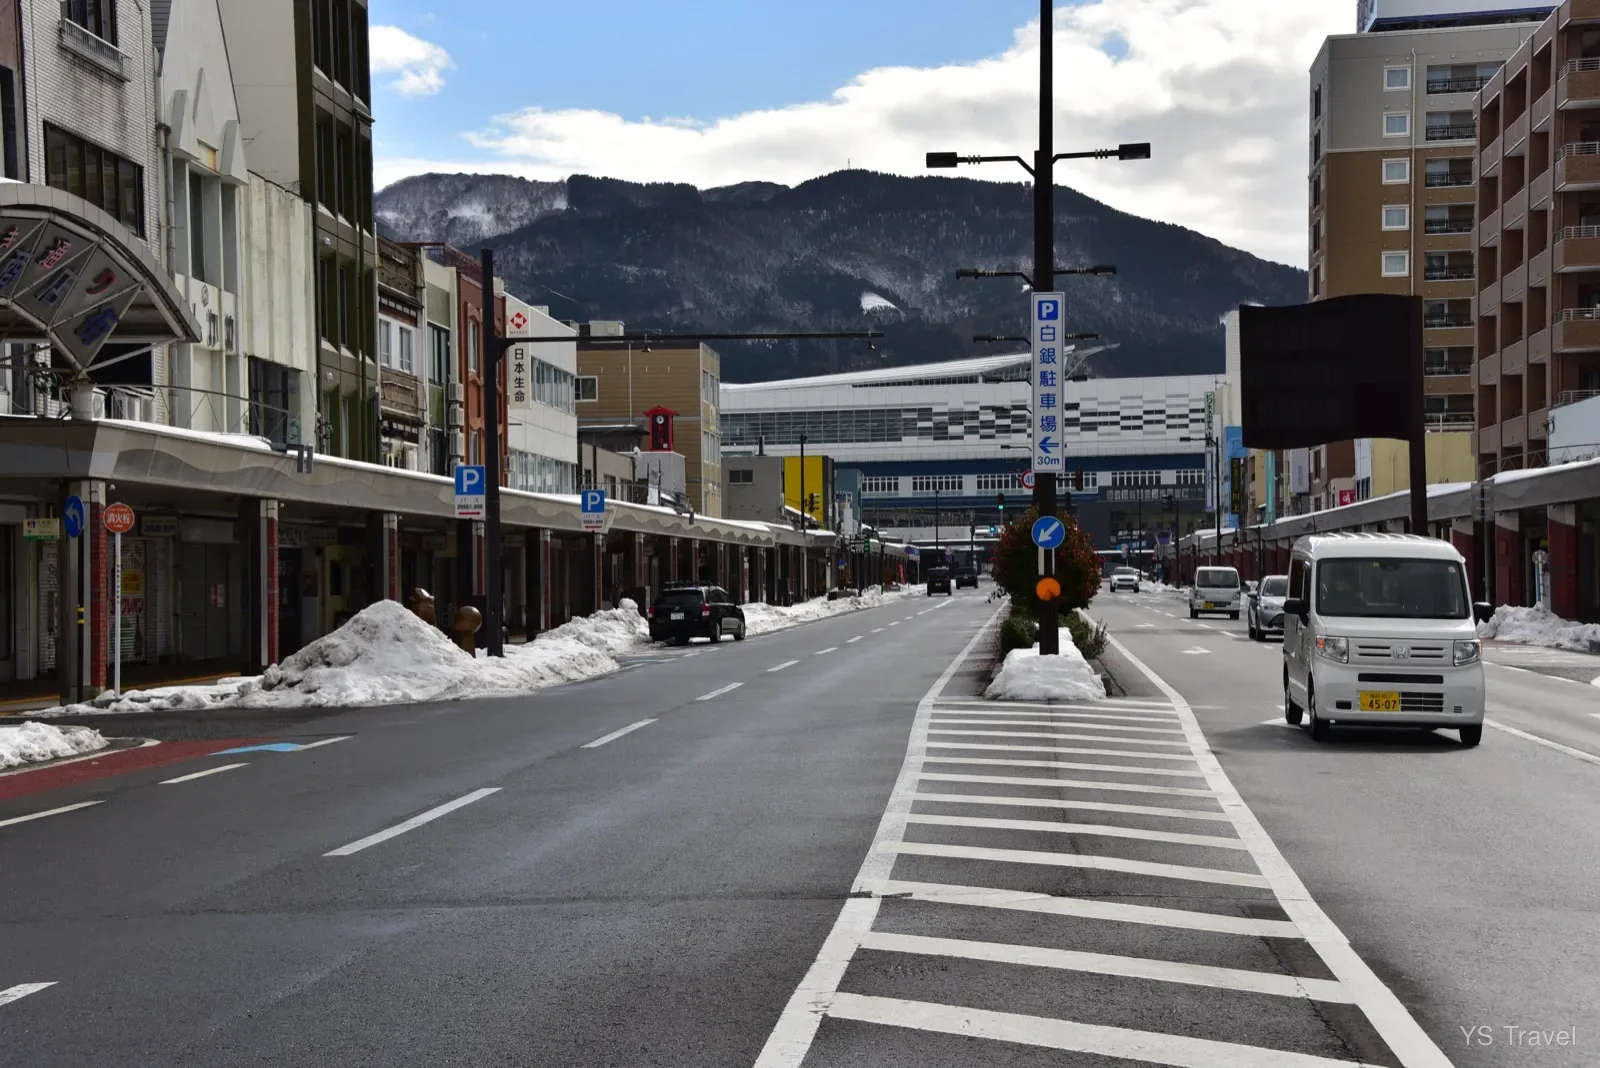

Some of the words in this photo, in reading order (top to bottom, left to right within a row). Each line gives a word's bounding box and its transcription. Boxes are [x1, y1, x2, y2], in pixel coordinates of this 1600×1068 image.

[1041, 302, 1054, 318] P
[514, 348, 525, 403] 日本生命
[1039, 325, 1057, 433] 白銀駐車場
[1037, 456, 1060, 466] 30m
[462, 468, 479, 493] P
[587, 492, 600, 511] P
[107, 512, 131, 524] 消火栓
[1368, 699, 1397, 710] 45-07
